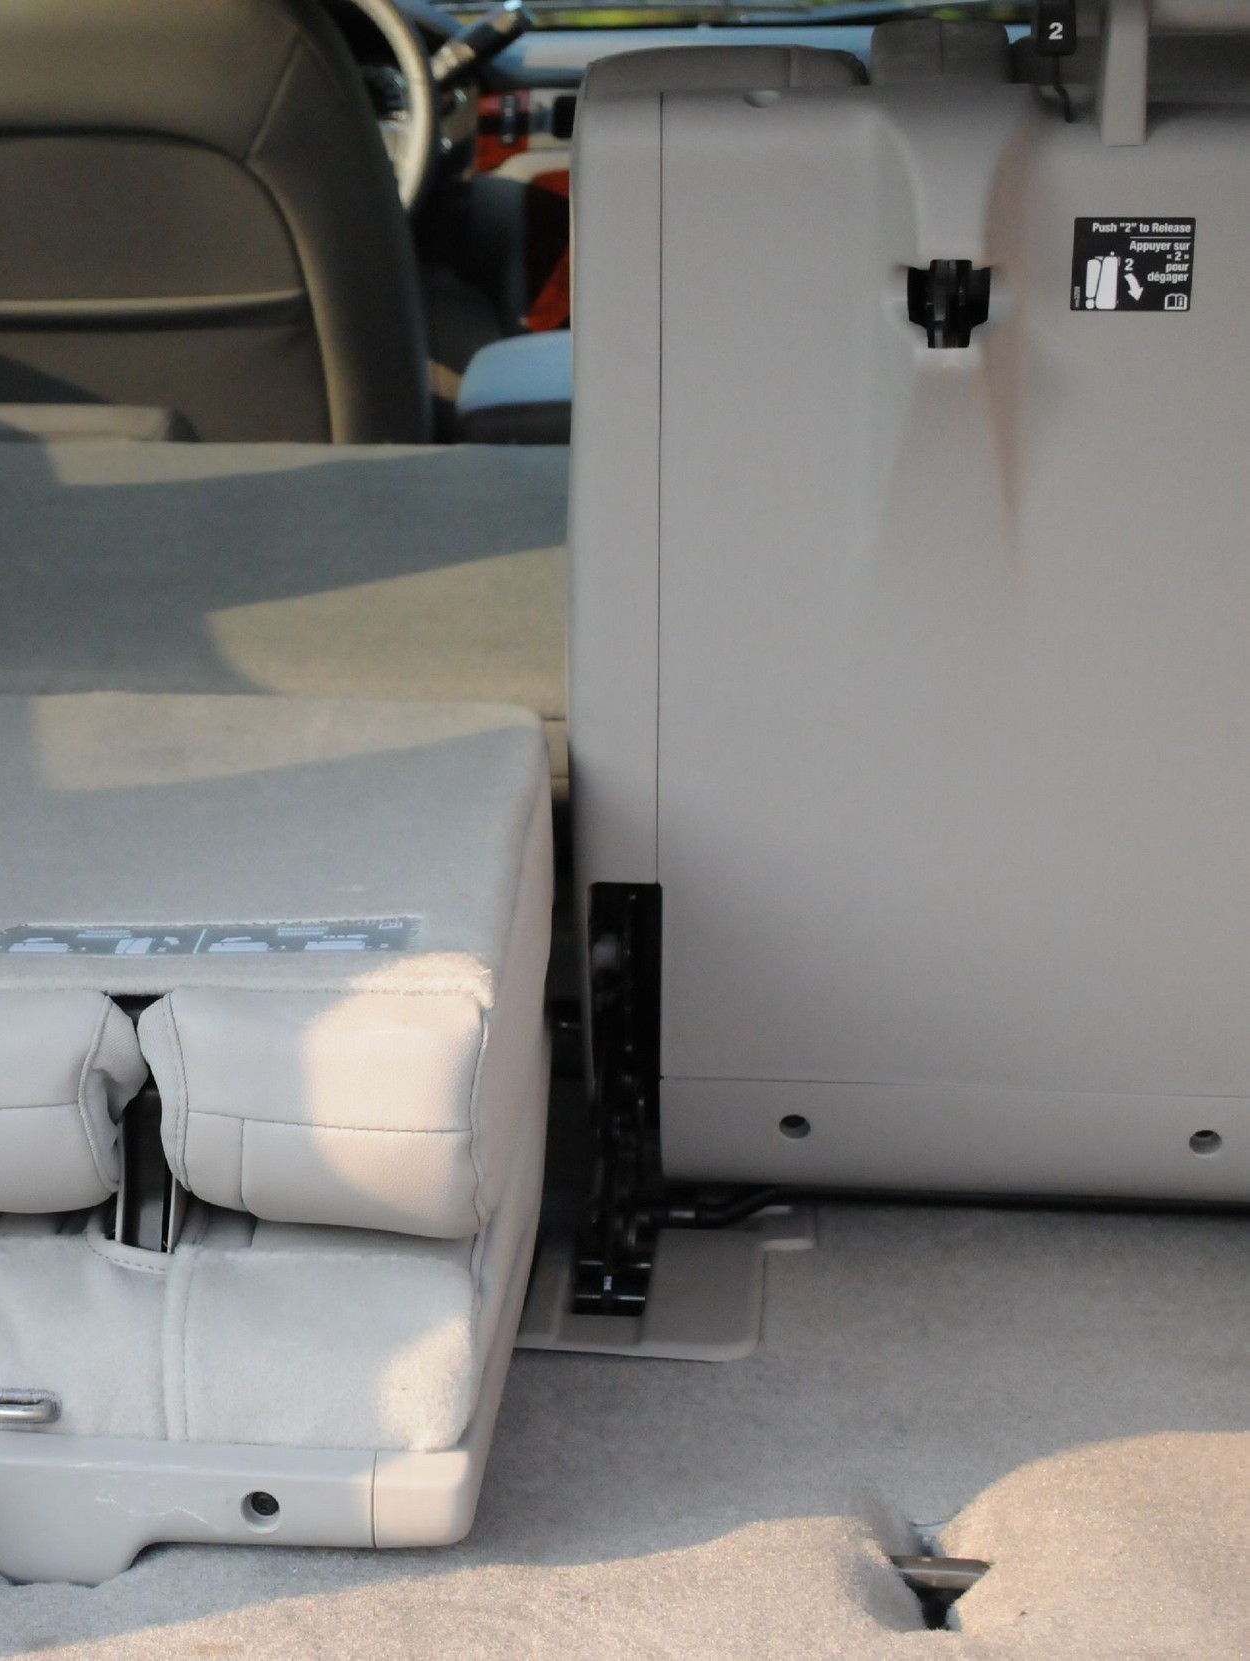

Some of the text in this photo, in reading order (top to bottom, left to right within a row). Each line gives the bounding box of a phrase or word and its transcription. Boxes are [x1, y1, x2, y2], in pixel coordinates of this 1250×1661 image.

[1049, 22, 1063, 40] 2
[1092, 222, 1191, 233] Push "2" to Release
[1129, 241, 1190, 253] Appuyer sur
[1124, 258, 1134, 271] 2
[1165, 263, 1189, 273] pour
[1147, 272, 1189, 284] dégager
